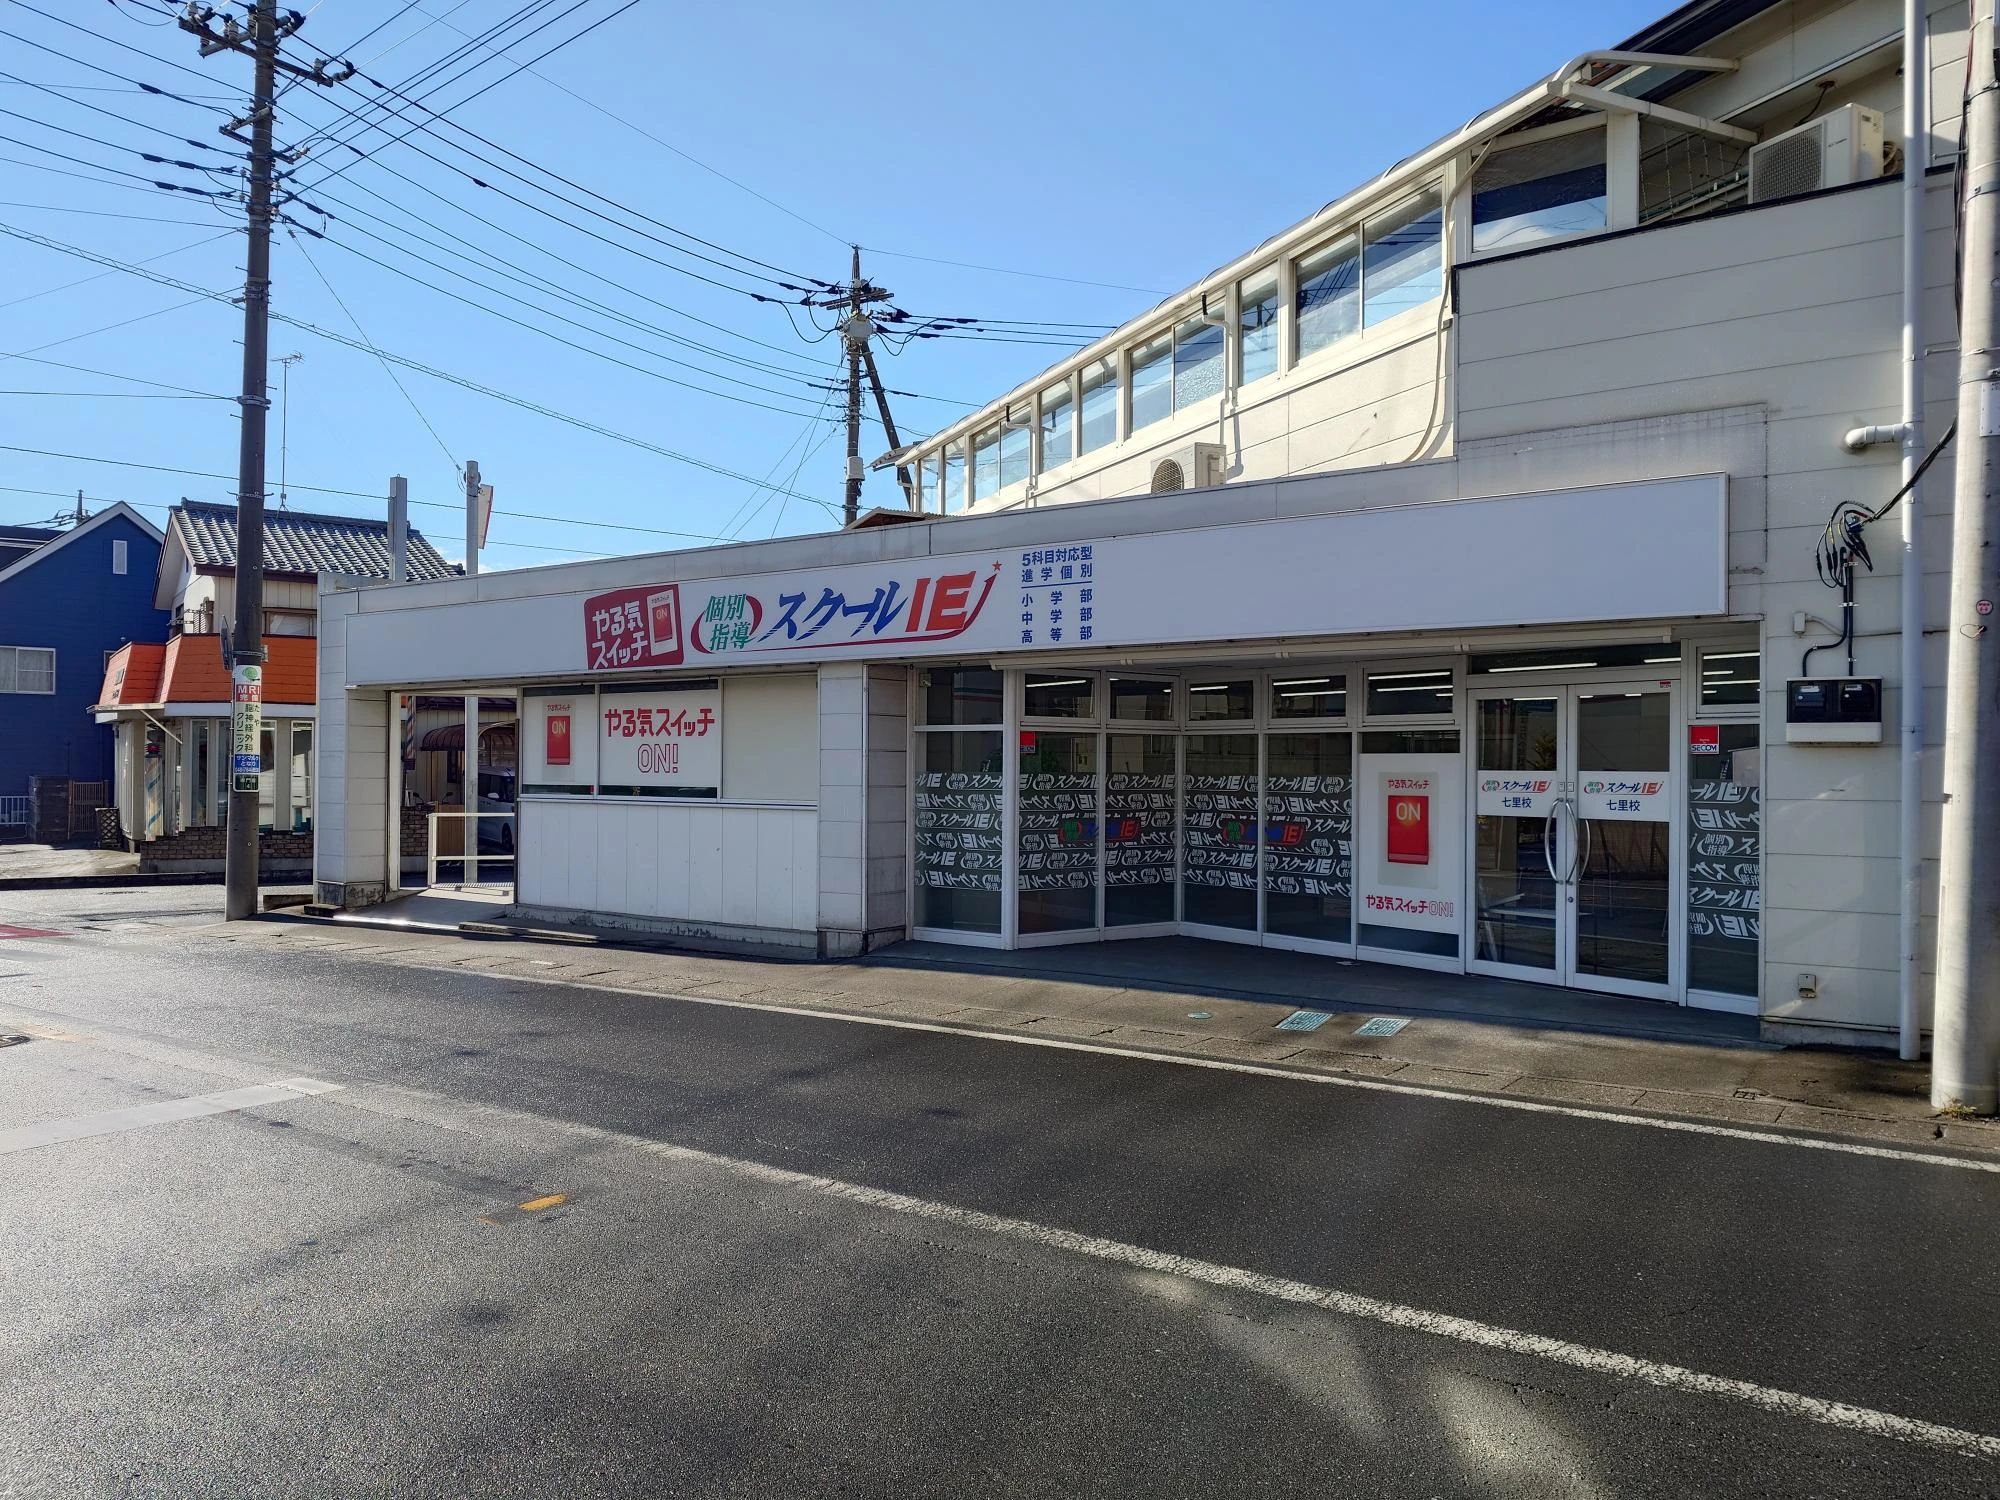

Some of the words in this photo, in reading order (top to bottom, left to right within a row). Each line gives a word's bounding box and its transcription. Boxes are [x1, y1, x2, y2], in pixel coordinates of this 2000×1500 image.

[1022, 545, 1092, 566] 5科目対応型
[1021, 563, 1092, 583] 進学個別
[758, 571, 977, 642] スクールIE
[1021, 589, 1092, 607] 小学部
[705, 593, 747, 623] 個別
[1021, 607, 1092, 625] 中学部
[592, 600, 644, 640] やる気
[709, 622, 752, 651] 指導
[1021, 626, 1092, 644] 高等部
[592, 631, 648, 670] スイッチ
[238, 685, 260, 694] MRI
[551, 721, 566, 734] ON
[605, 708, 715, 738] やる気スイッチ
[1692, 744, 1717, 752] SECOM
[638, 743, 679, 773] ON!
[1388, 779, 1430, 790] やる気スイッチ
[1396, 802, 1421, 821] ON
[1501, 797, 1532, 808] 七里校
[1606, 800, 1640, 812] 七里校
